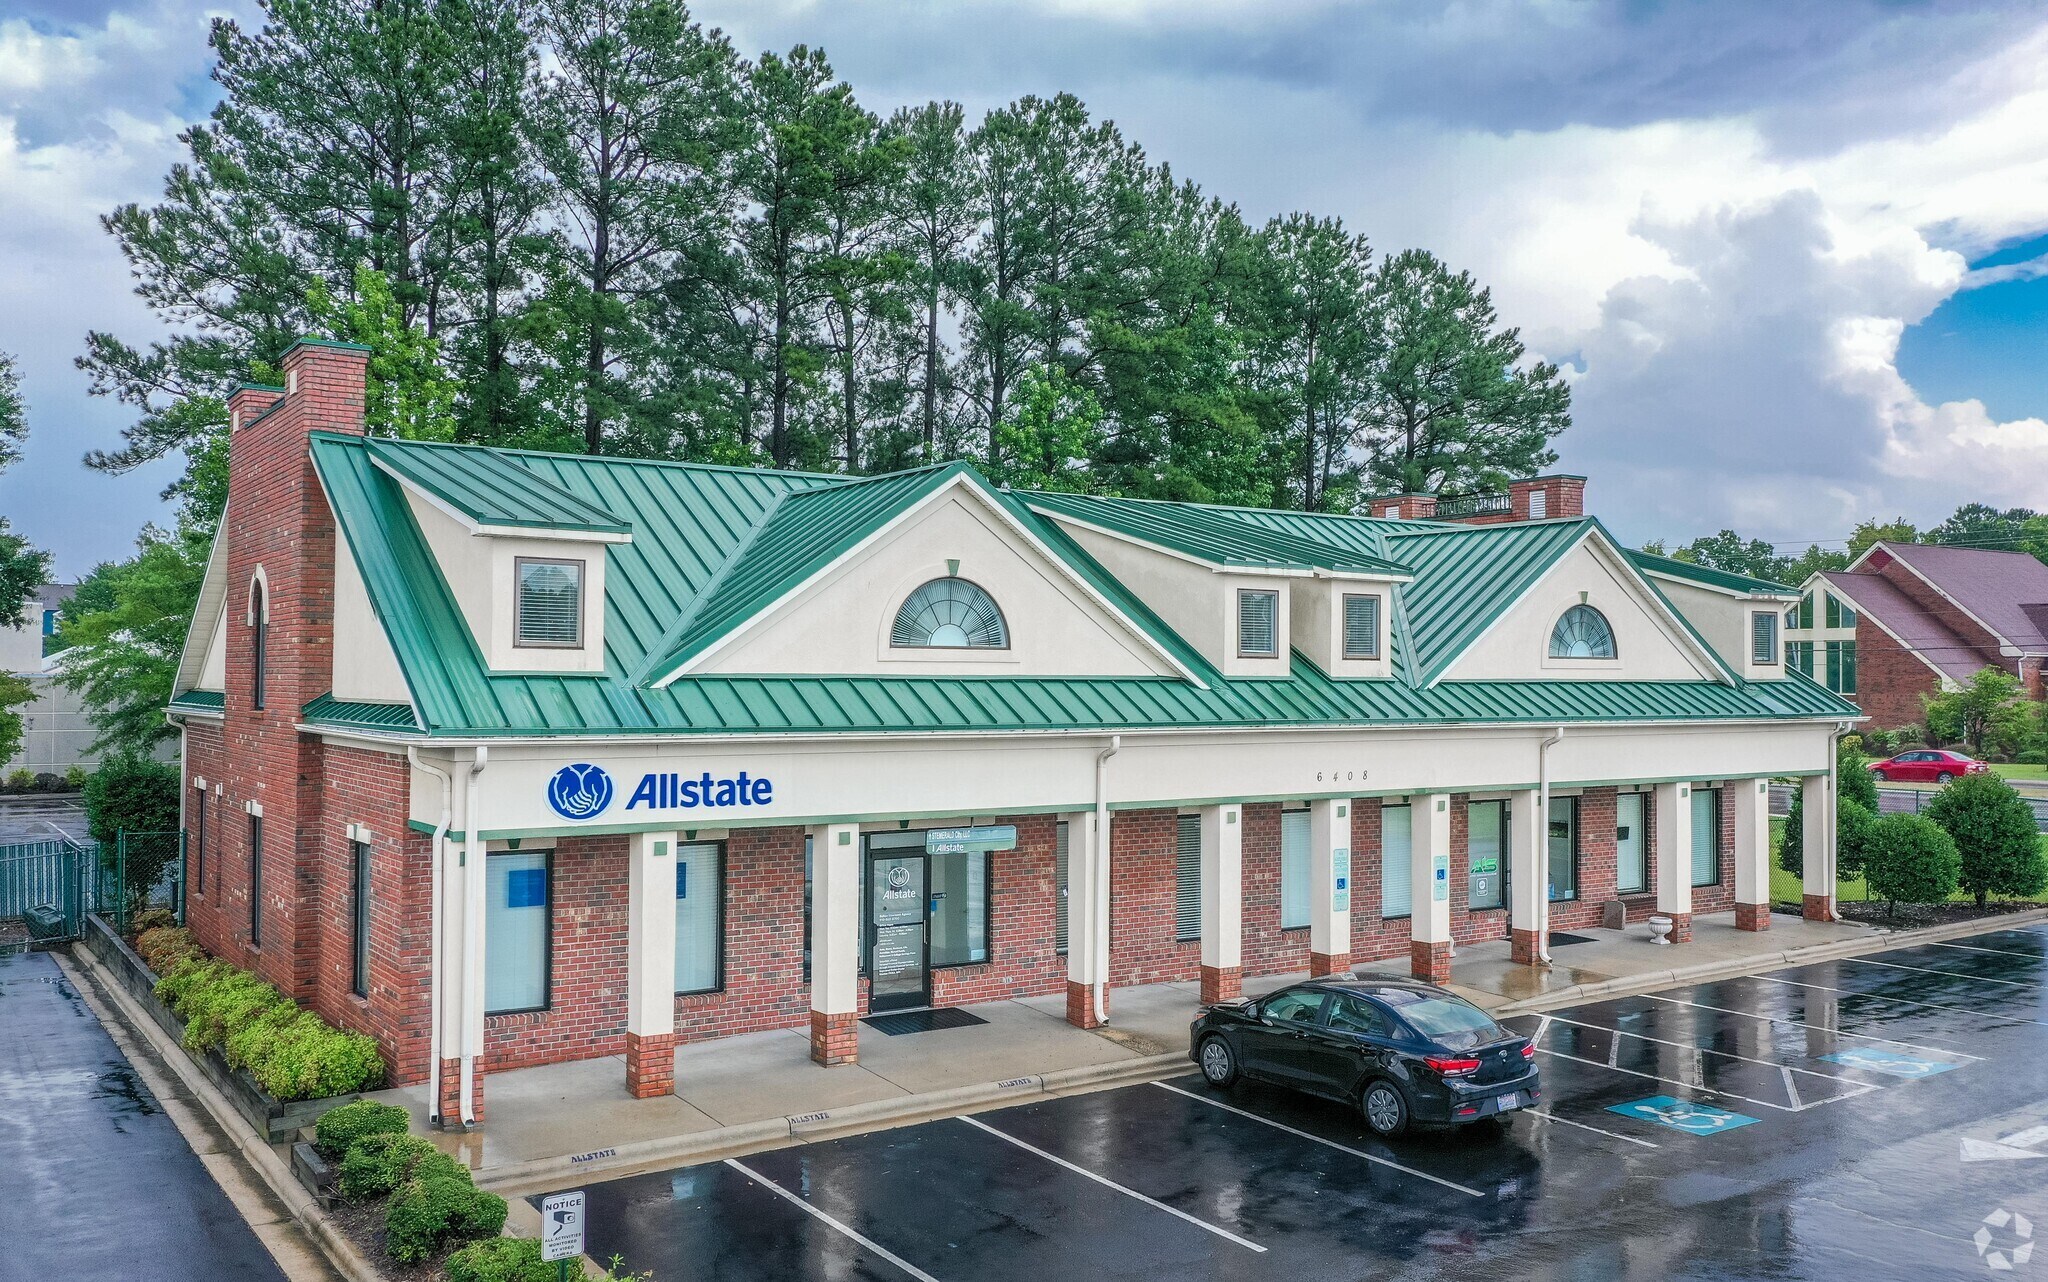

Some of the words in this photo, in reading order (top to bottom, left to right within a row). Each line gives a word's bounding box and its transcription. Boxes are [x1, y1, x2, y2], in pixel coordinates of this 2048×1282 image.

[1317, 770, 1368, 782] 6408
[625, 772, 772, 810] Allstate
[936, 844, 964, 853] Allstate
[883, 889, 916, 900] Allstate
[998, 1078, 1032, 1088] ALLSTATE
[791, 1112, 830, 1124] ALLSTATE
[571, 1149, 616, 1163] ALLSTATE
[546, 1199, 582, 1210] NOTICE
[549, 1239, 577, 1247] MONITORED
